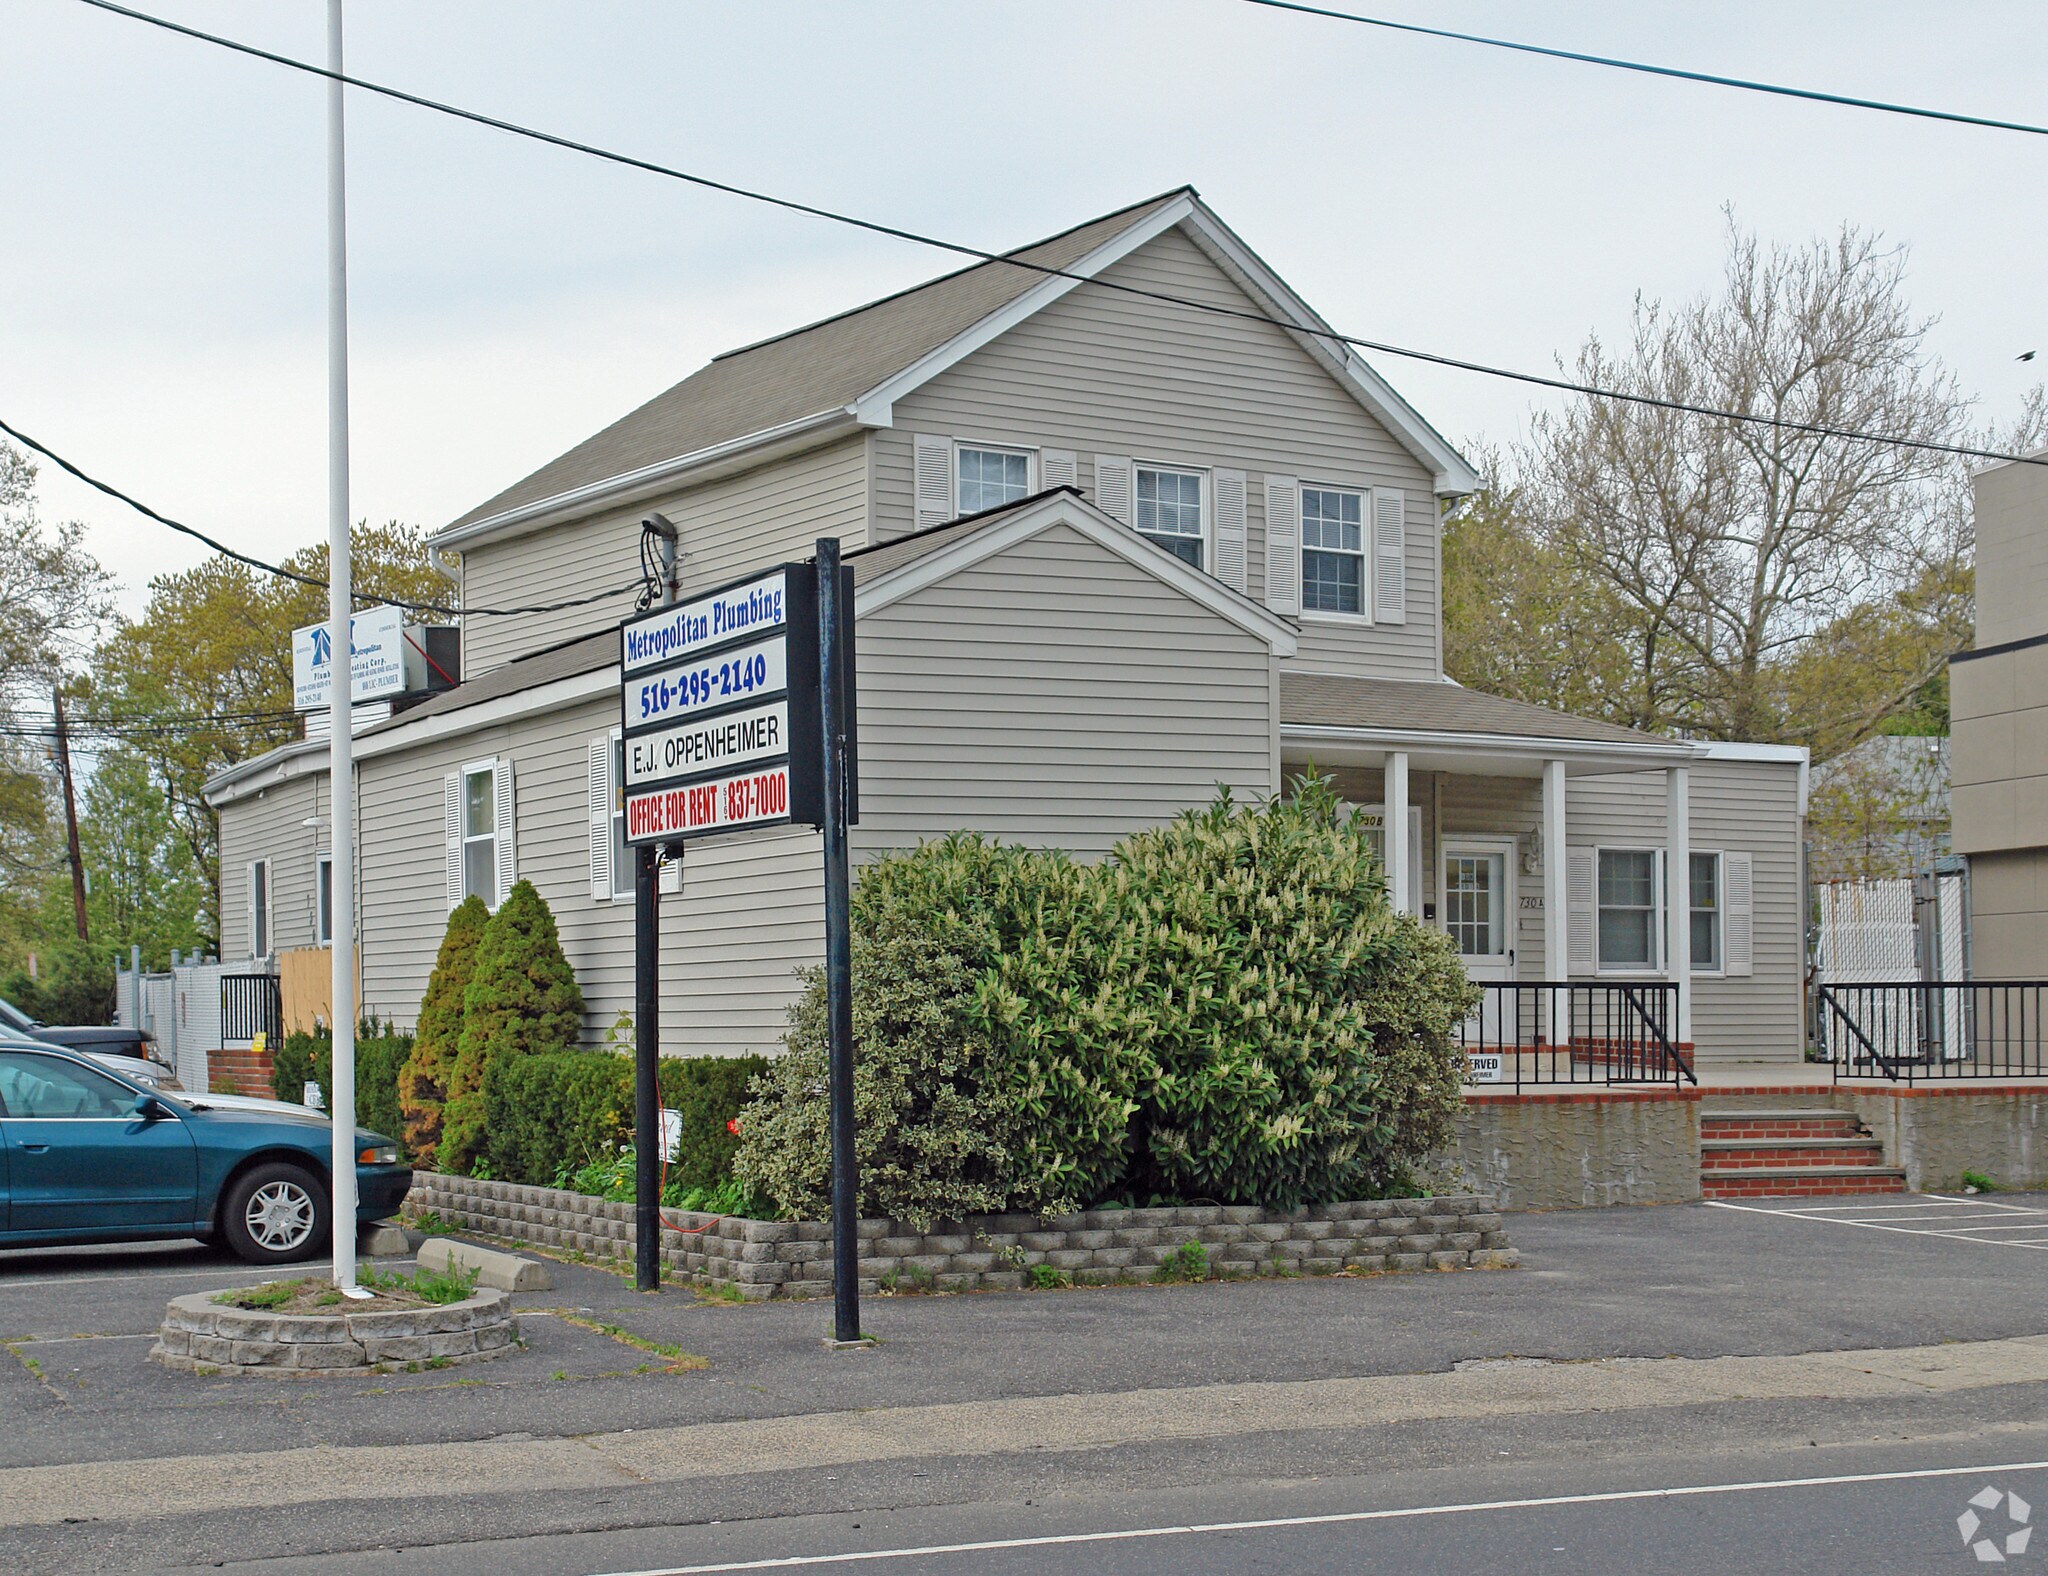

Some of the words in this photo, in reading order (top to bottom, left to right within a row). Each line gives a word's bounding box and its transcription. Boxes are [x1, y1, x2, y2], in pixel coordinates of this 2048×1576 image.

[628, 614, 708, 662] Metropolitan
[713, 588, 781, 635] Plumbing
[351, 661, 369, 672] eating
[641, 653, 766, 718] 516-295-2140
[633, 743, 658, 774] E.J.
[665, 715, 778, 768] OPPENHEIMER
[630, 794, 664, 837] OFFICE
[666, 790, 686, 830] FOR
[689, 784, 717, 827] RENT
[728, 771, 786, 822] 837-7000
[1520, 896, 1537, 908] 730
